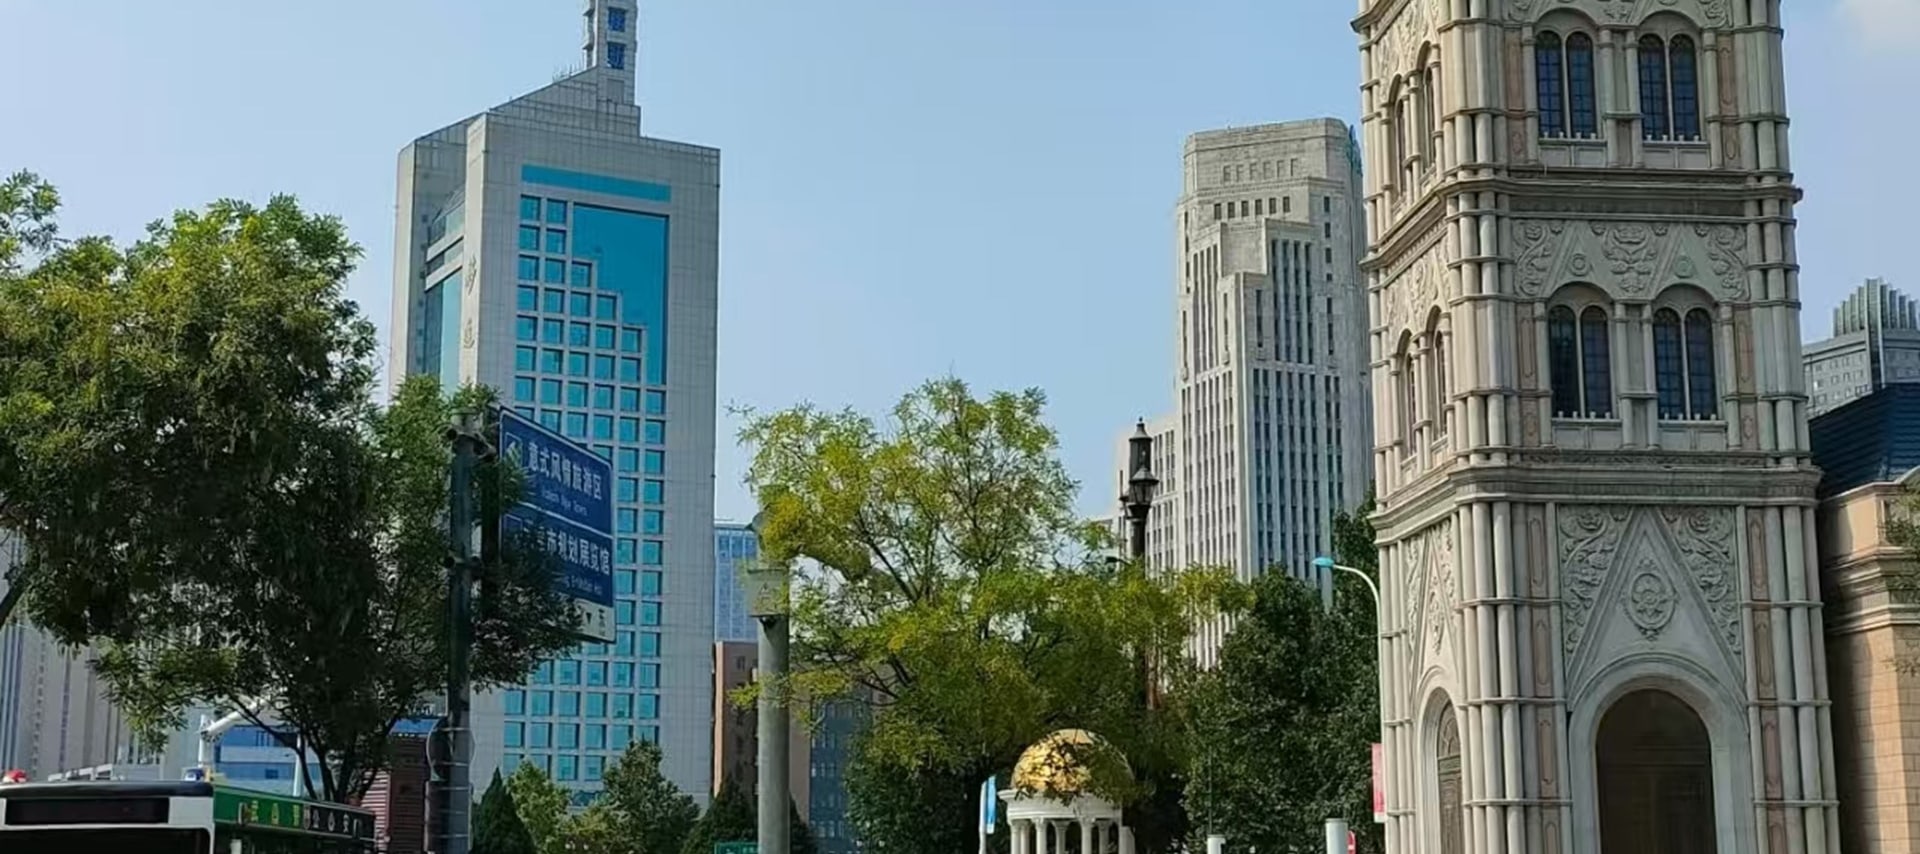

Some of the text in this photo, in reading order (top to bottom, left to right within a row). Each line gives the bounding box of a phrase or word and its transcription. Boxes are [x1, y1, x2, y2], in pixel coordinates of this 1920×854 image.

[528, 441, 602, 500] 意式风情旅游区
[523, 518, 610, 576] 市规划展览馆
